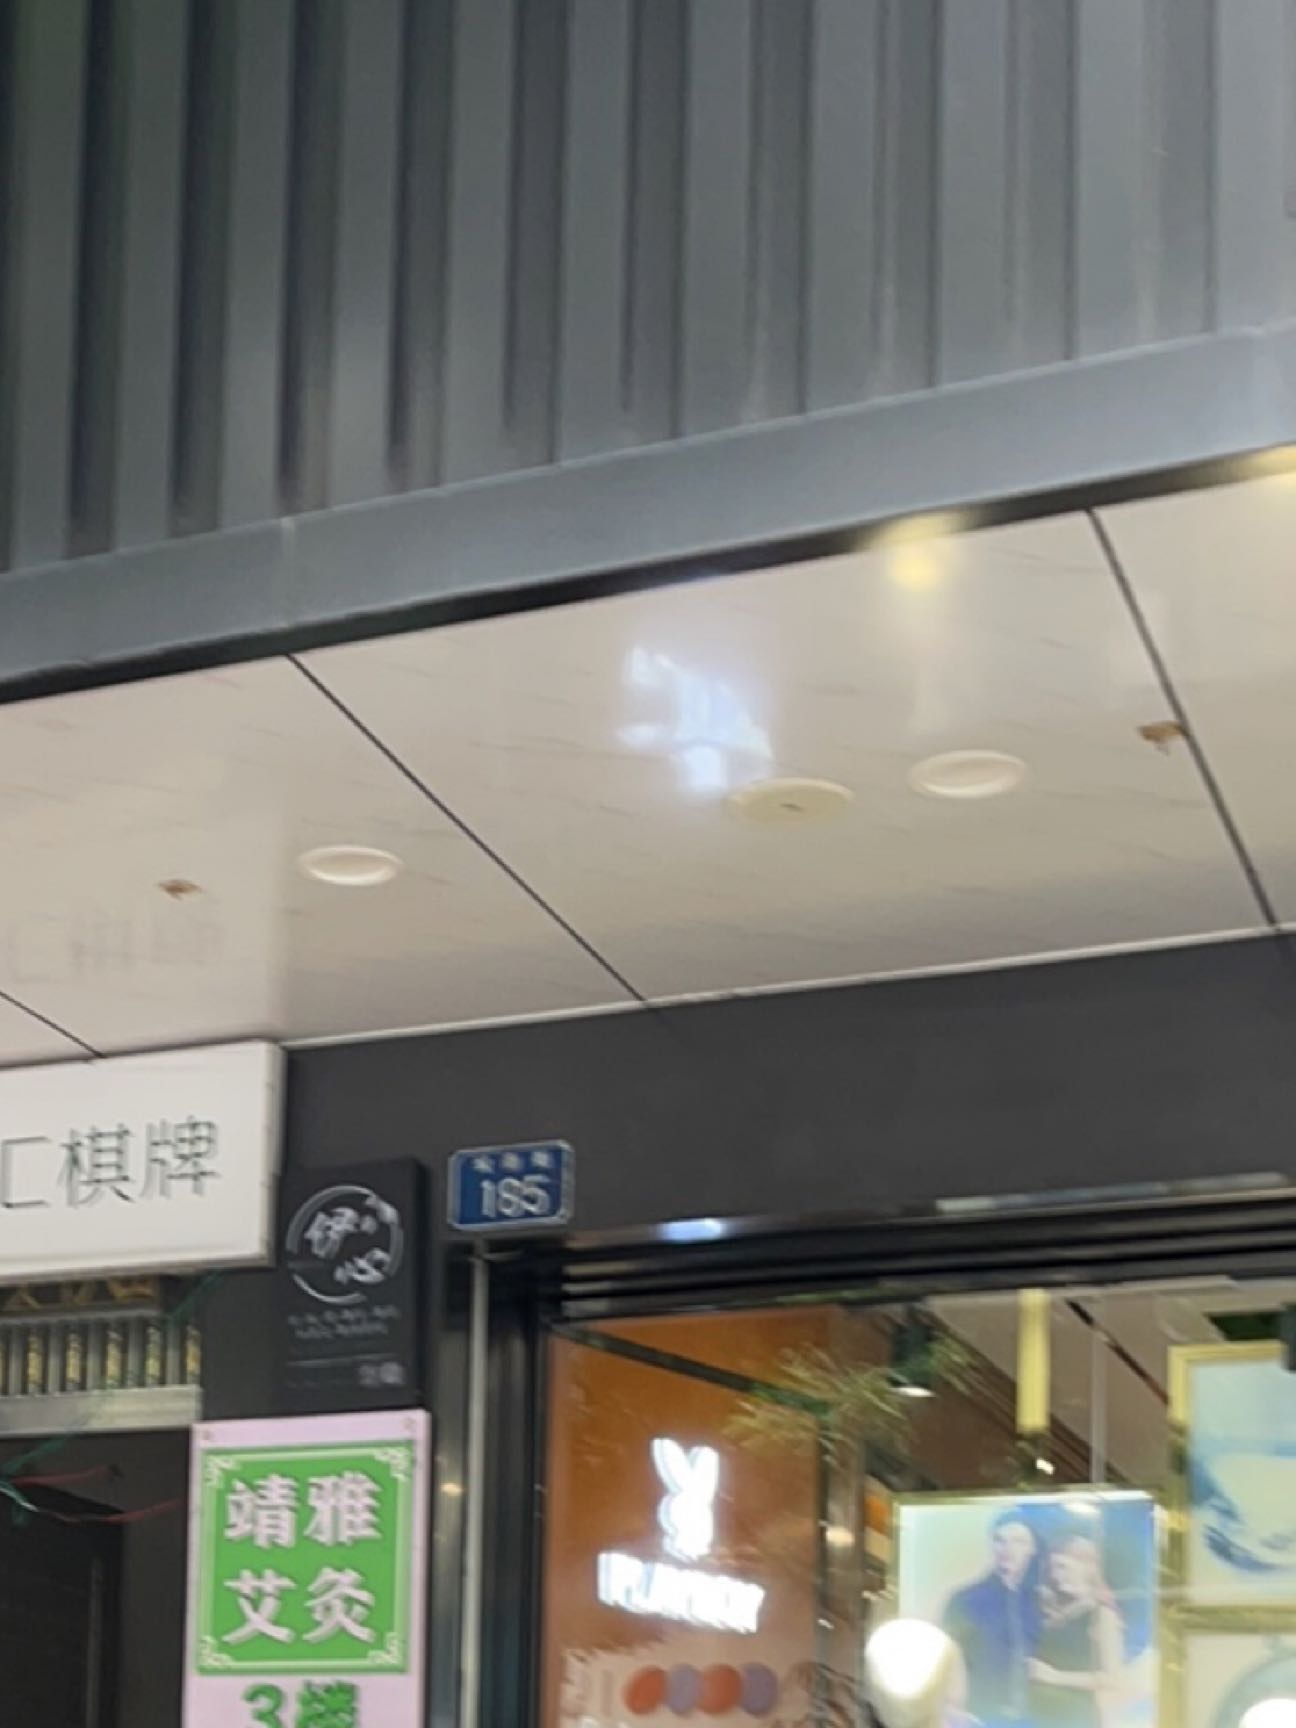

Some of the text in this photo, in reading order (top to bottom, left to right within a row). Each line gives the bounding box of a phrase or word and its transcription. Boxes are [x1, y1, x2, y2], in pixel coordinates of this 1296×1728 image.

[481, 1174, 552, 1218] 185
[223, 1470, 384, 1549] 靖雅
[221, 1566, 377, 1646] 艾灸
